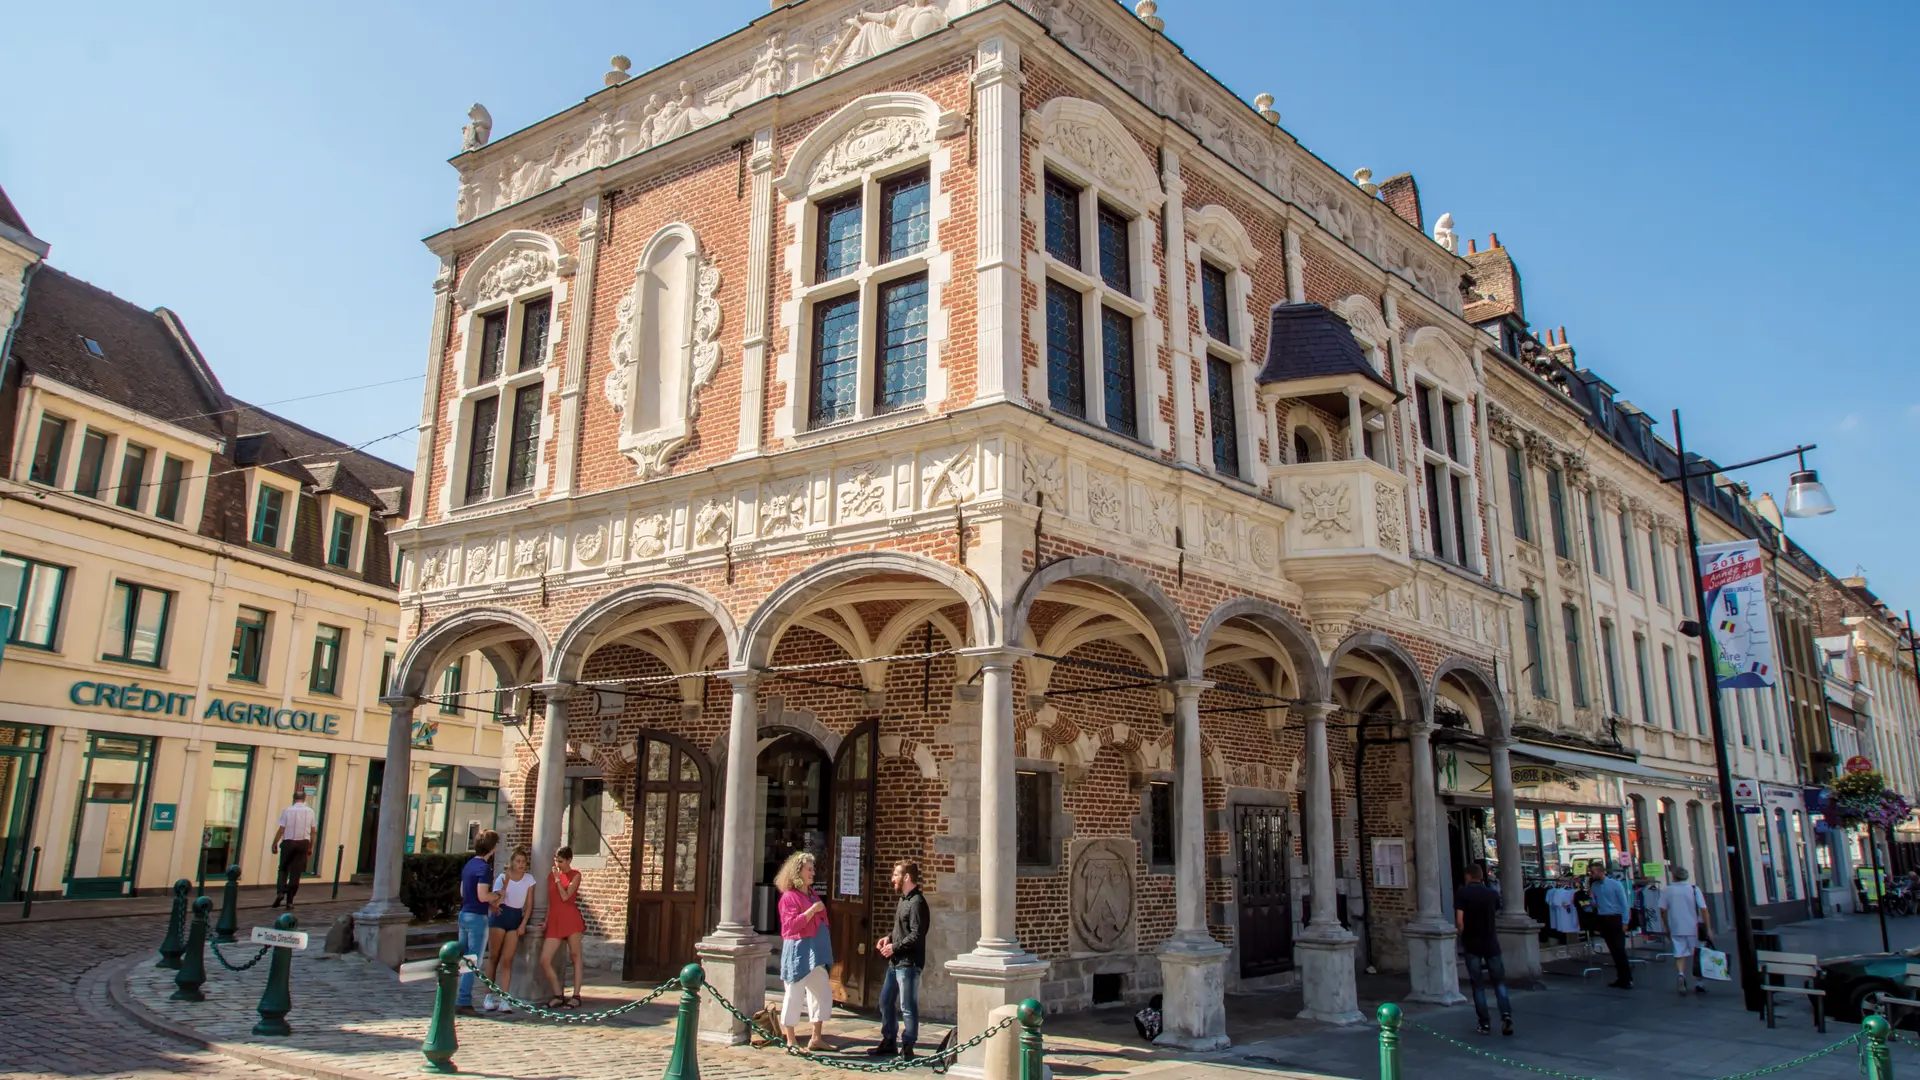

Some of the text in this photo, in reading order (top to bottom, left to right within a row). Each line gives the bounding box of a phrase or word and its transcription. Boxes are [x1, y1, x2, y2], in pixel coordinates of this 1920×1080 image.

[1712, 554, 1744, 571] 2016
[1709, 561, 1755, 582] Année du
[1709, 570, 1753, 590] Jumelage
[1719, 651, 1741, 661] Aire
[1728, 661, 1742, 670] Lys
[69, 680, 340, 735] CRÉDIT AGRICOLE
[1511, 768, 1539, 784] OOK
